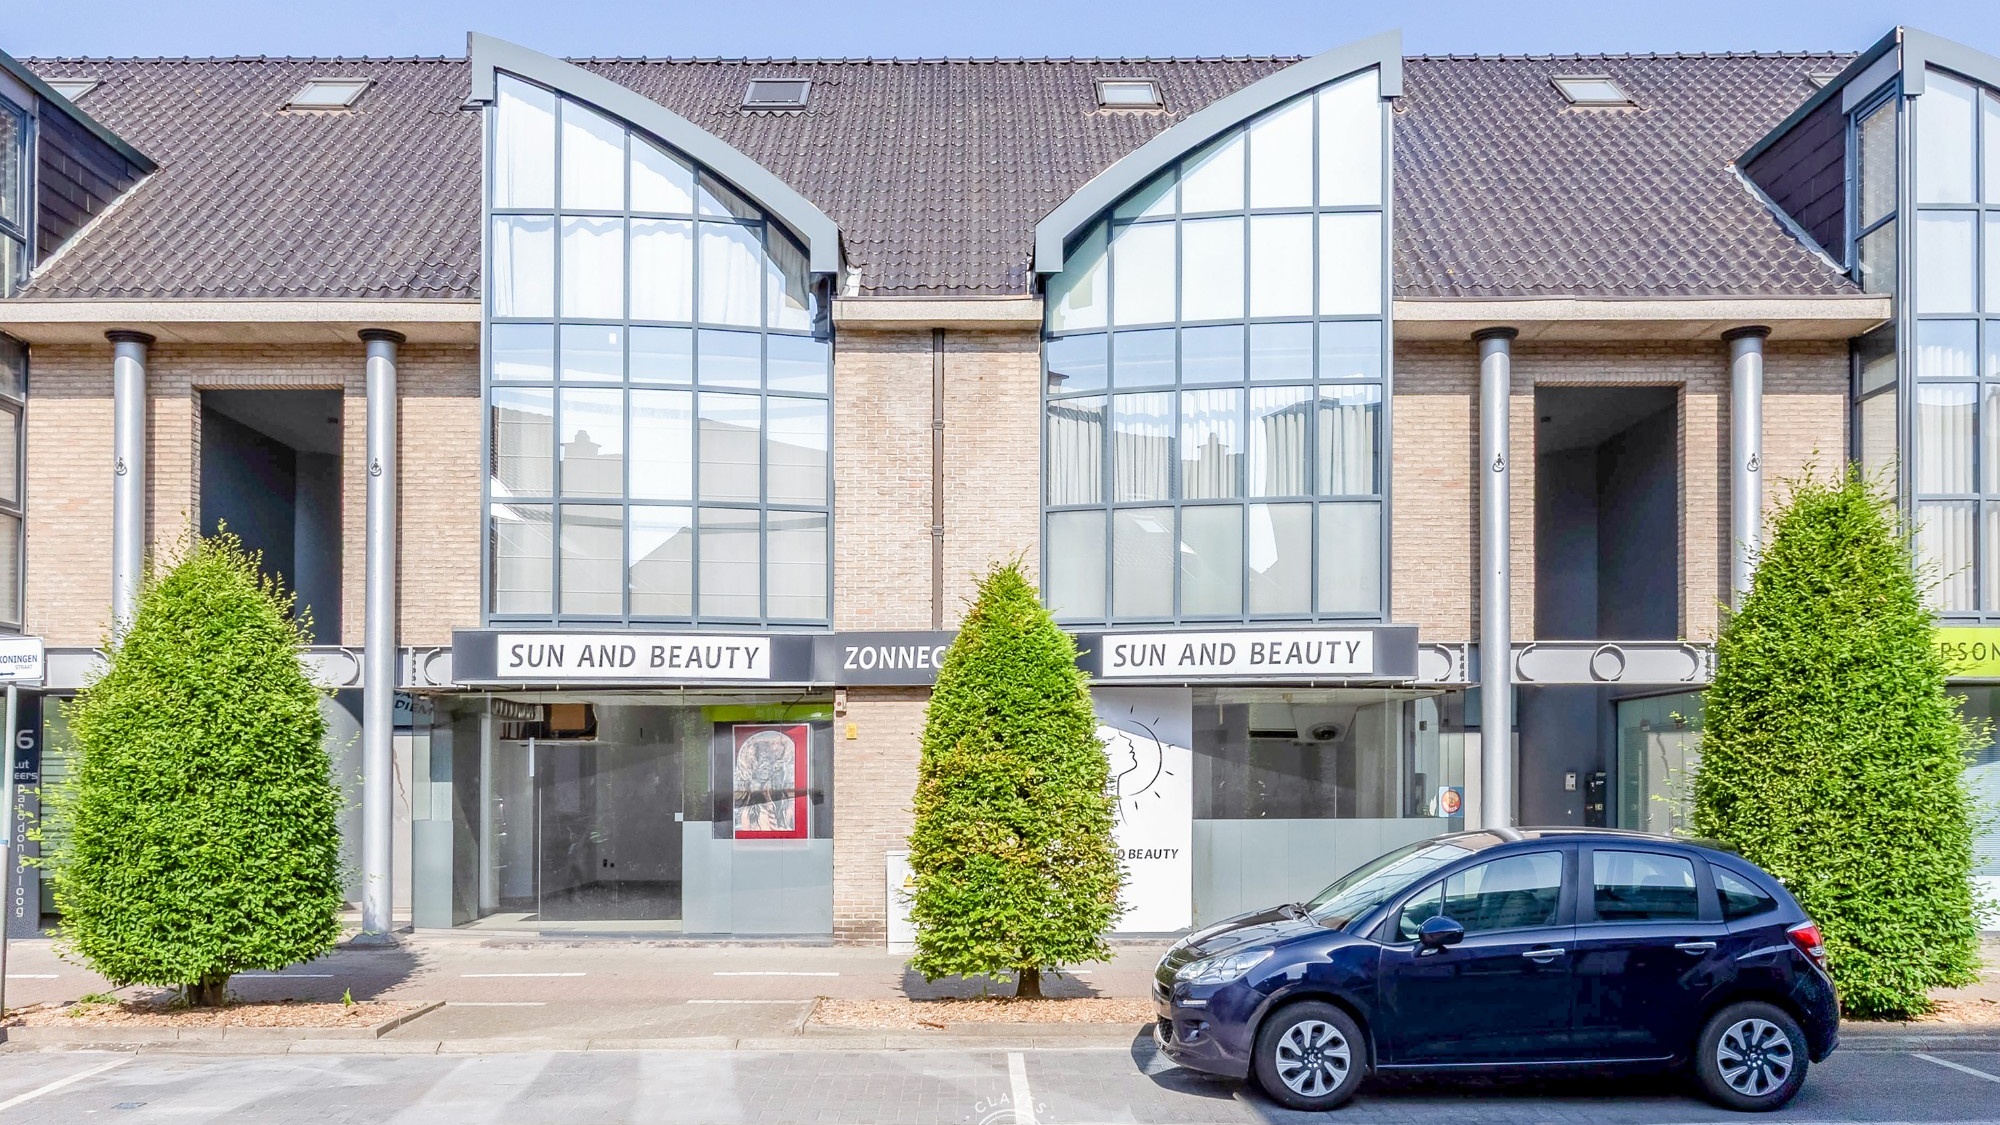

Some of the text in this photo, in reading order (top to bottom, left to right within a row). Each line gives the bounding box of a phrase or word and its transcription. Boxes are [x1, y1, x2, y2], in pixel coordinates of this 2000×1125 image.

[510, 644, 760, 669] SUN AND BEAUTY
[844, 646, 951, 670] ZONNEC
[1113, 641, 1361, 667] SUN AND BEAUTY
[16, 729, 34, 749] 6
[14, 772, 38, 780] eers
[1128, 848, 1179, 860] BEAUTY
